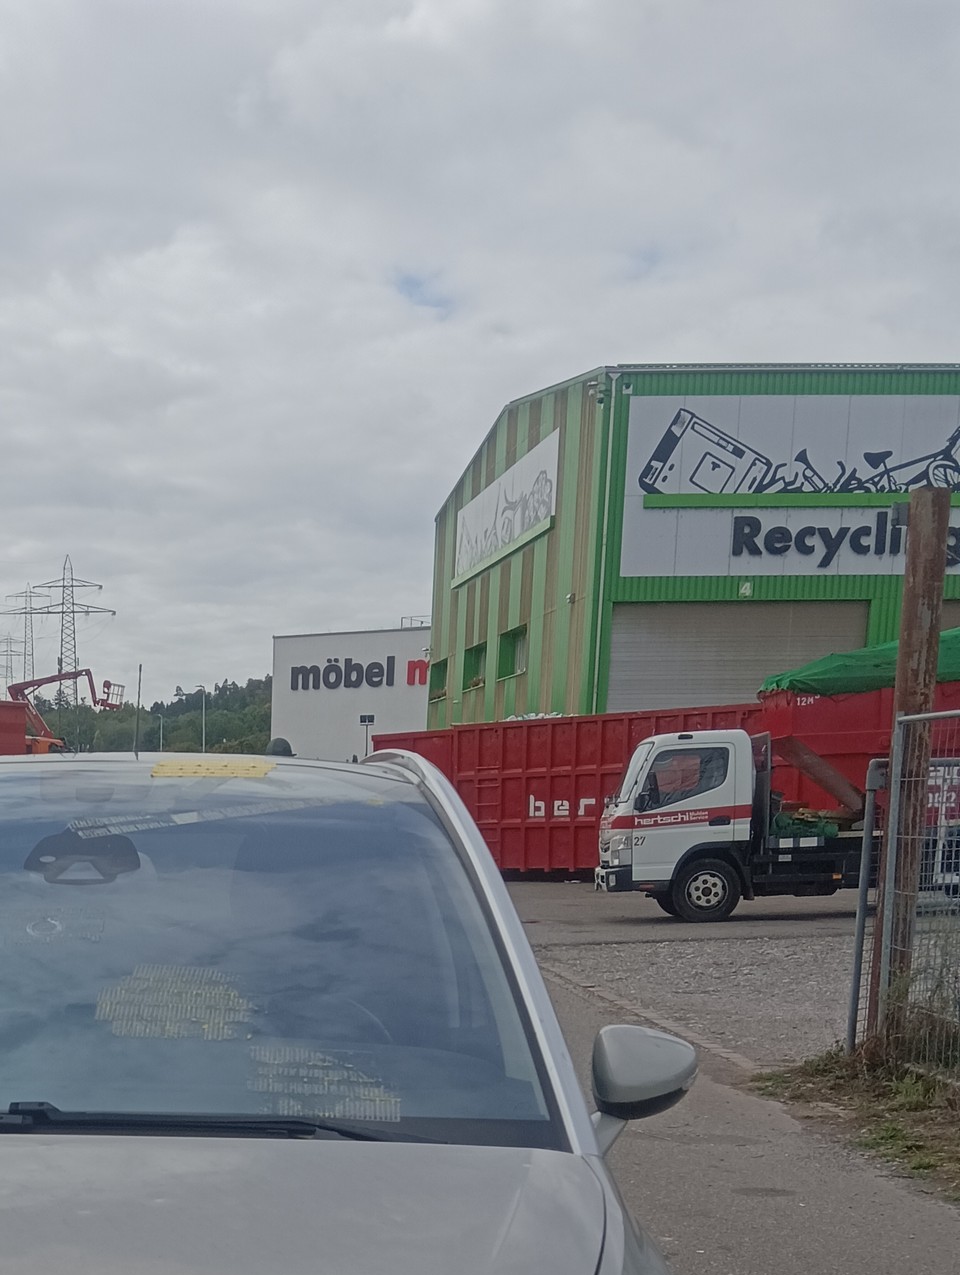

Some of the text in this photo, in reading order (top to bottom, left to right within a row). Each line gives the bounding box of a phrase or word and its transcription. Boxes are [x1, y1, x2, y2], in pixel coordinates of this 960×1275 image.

[731, 510, 960, 568] Recyclig
[740, 583, 751, 597] 4
[290, 656, 395, 690] möbel
[633, 836, 646, 847] 27
